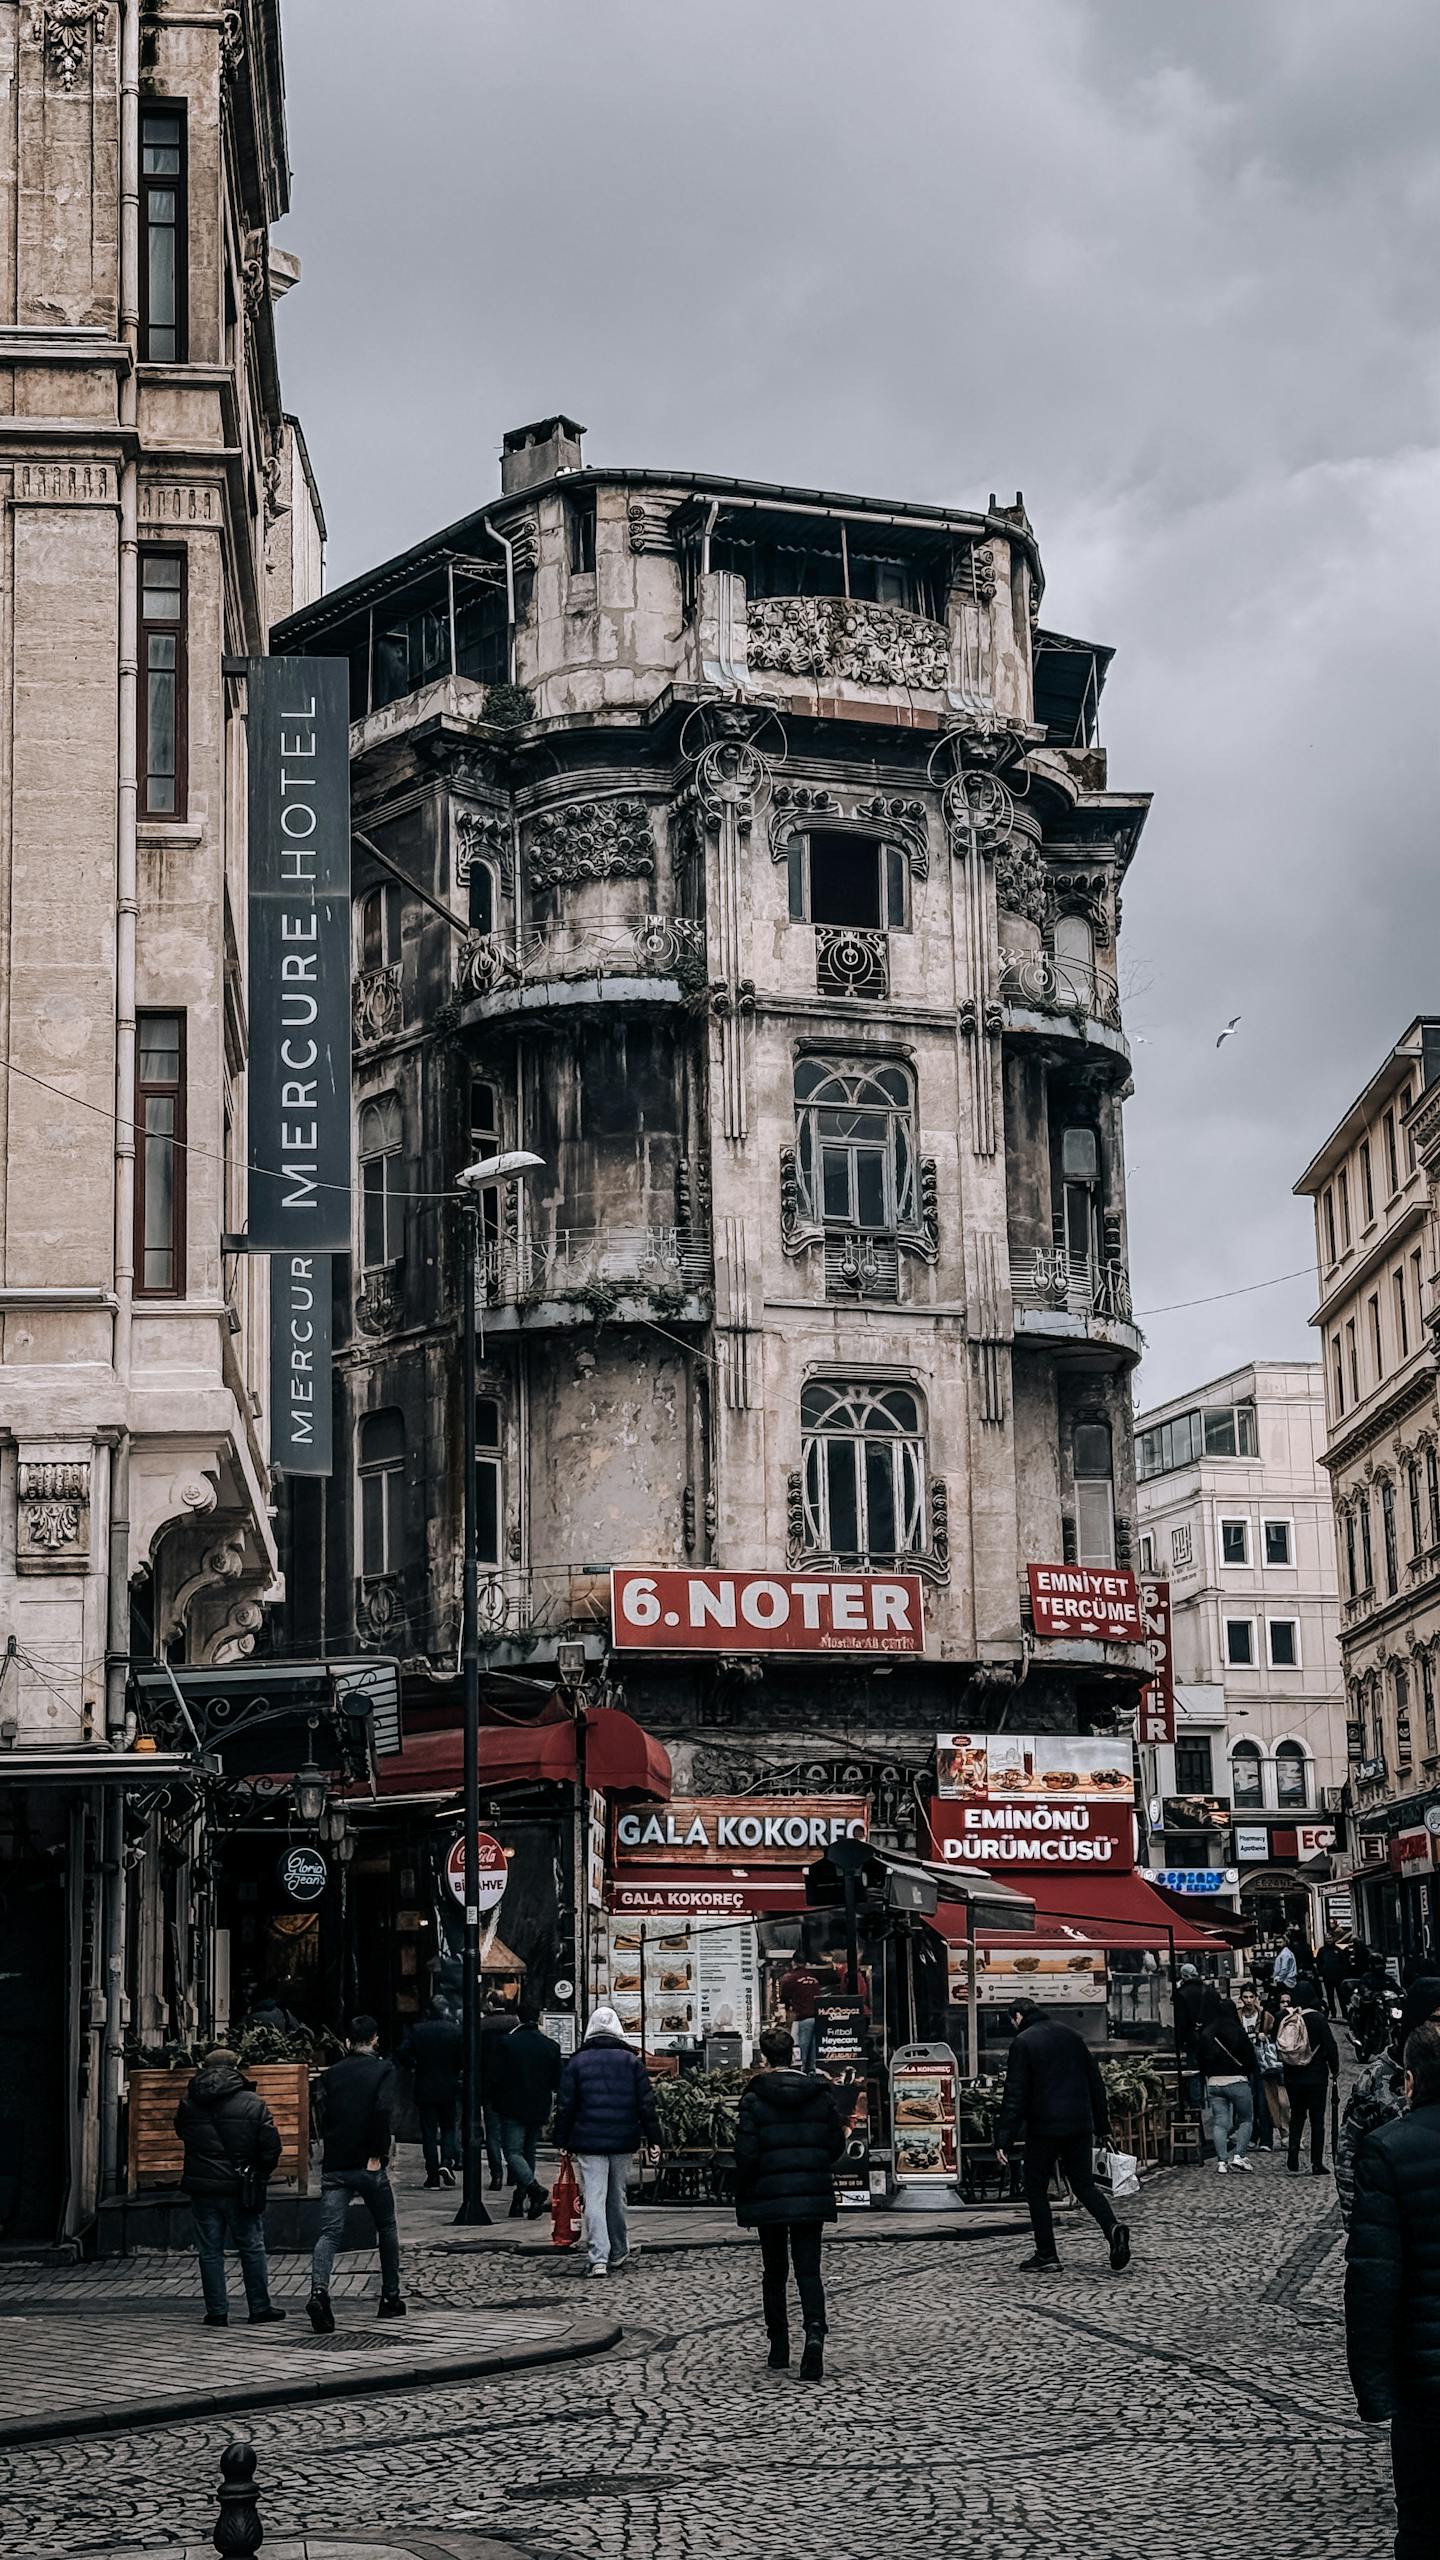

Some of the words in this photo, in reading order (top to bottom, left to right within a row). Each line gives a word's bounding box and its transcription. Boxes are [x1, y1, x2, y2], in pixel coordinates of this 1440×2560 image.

[281, 696, 317, 879] HOTEL
[281, 913, 318, 1207] MERCURE
[1036, 1570, 1129, 1597] EMNİYET
[1036, 1596, 1138, 1623] TERCÜME
[617, 1815, 710, 1847] GALA
[963, 1804, 1090, 1831] EMİNÖNÜ
[943, 1833, 1112, 1862] DÜRÜMCÜSÜ
[286, 1857, 323, 1875] Gloria
[621, 1892, 664, 1905] GALA
[667, 1892, 744, 1908] KOKOREÇ
[826, 2027, 853, 2036] Futbol
